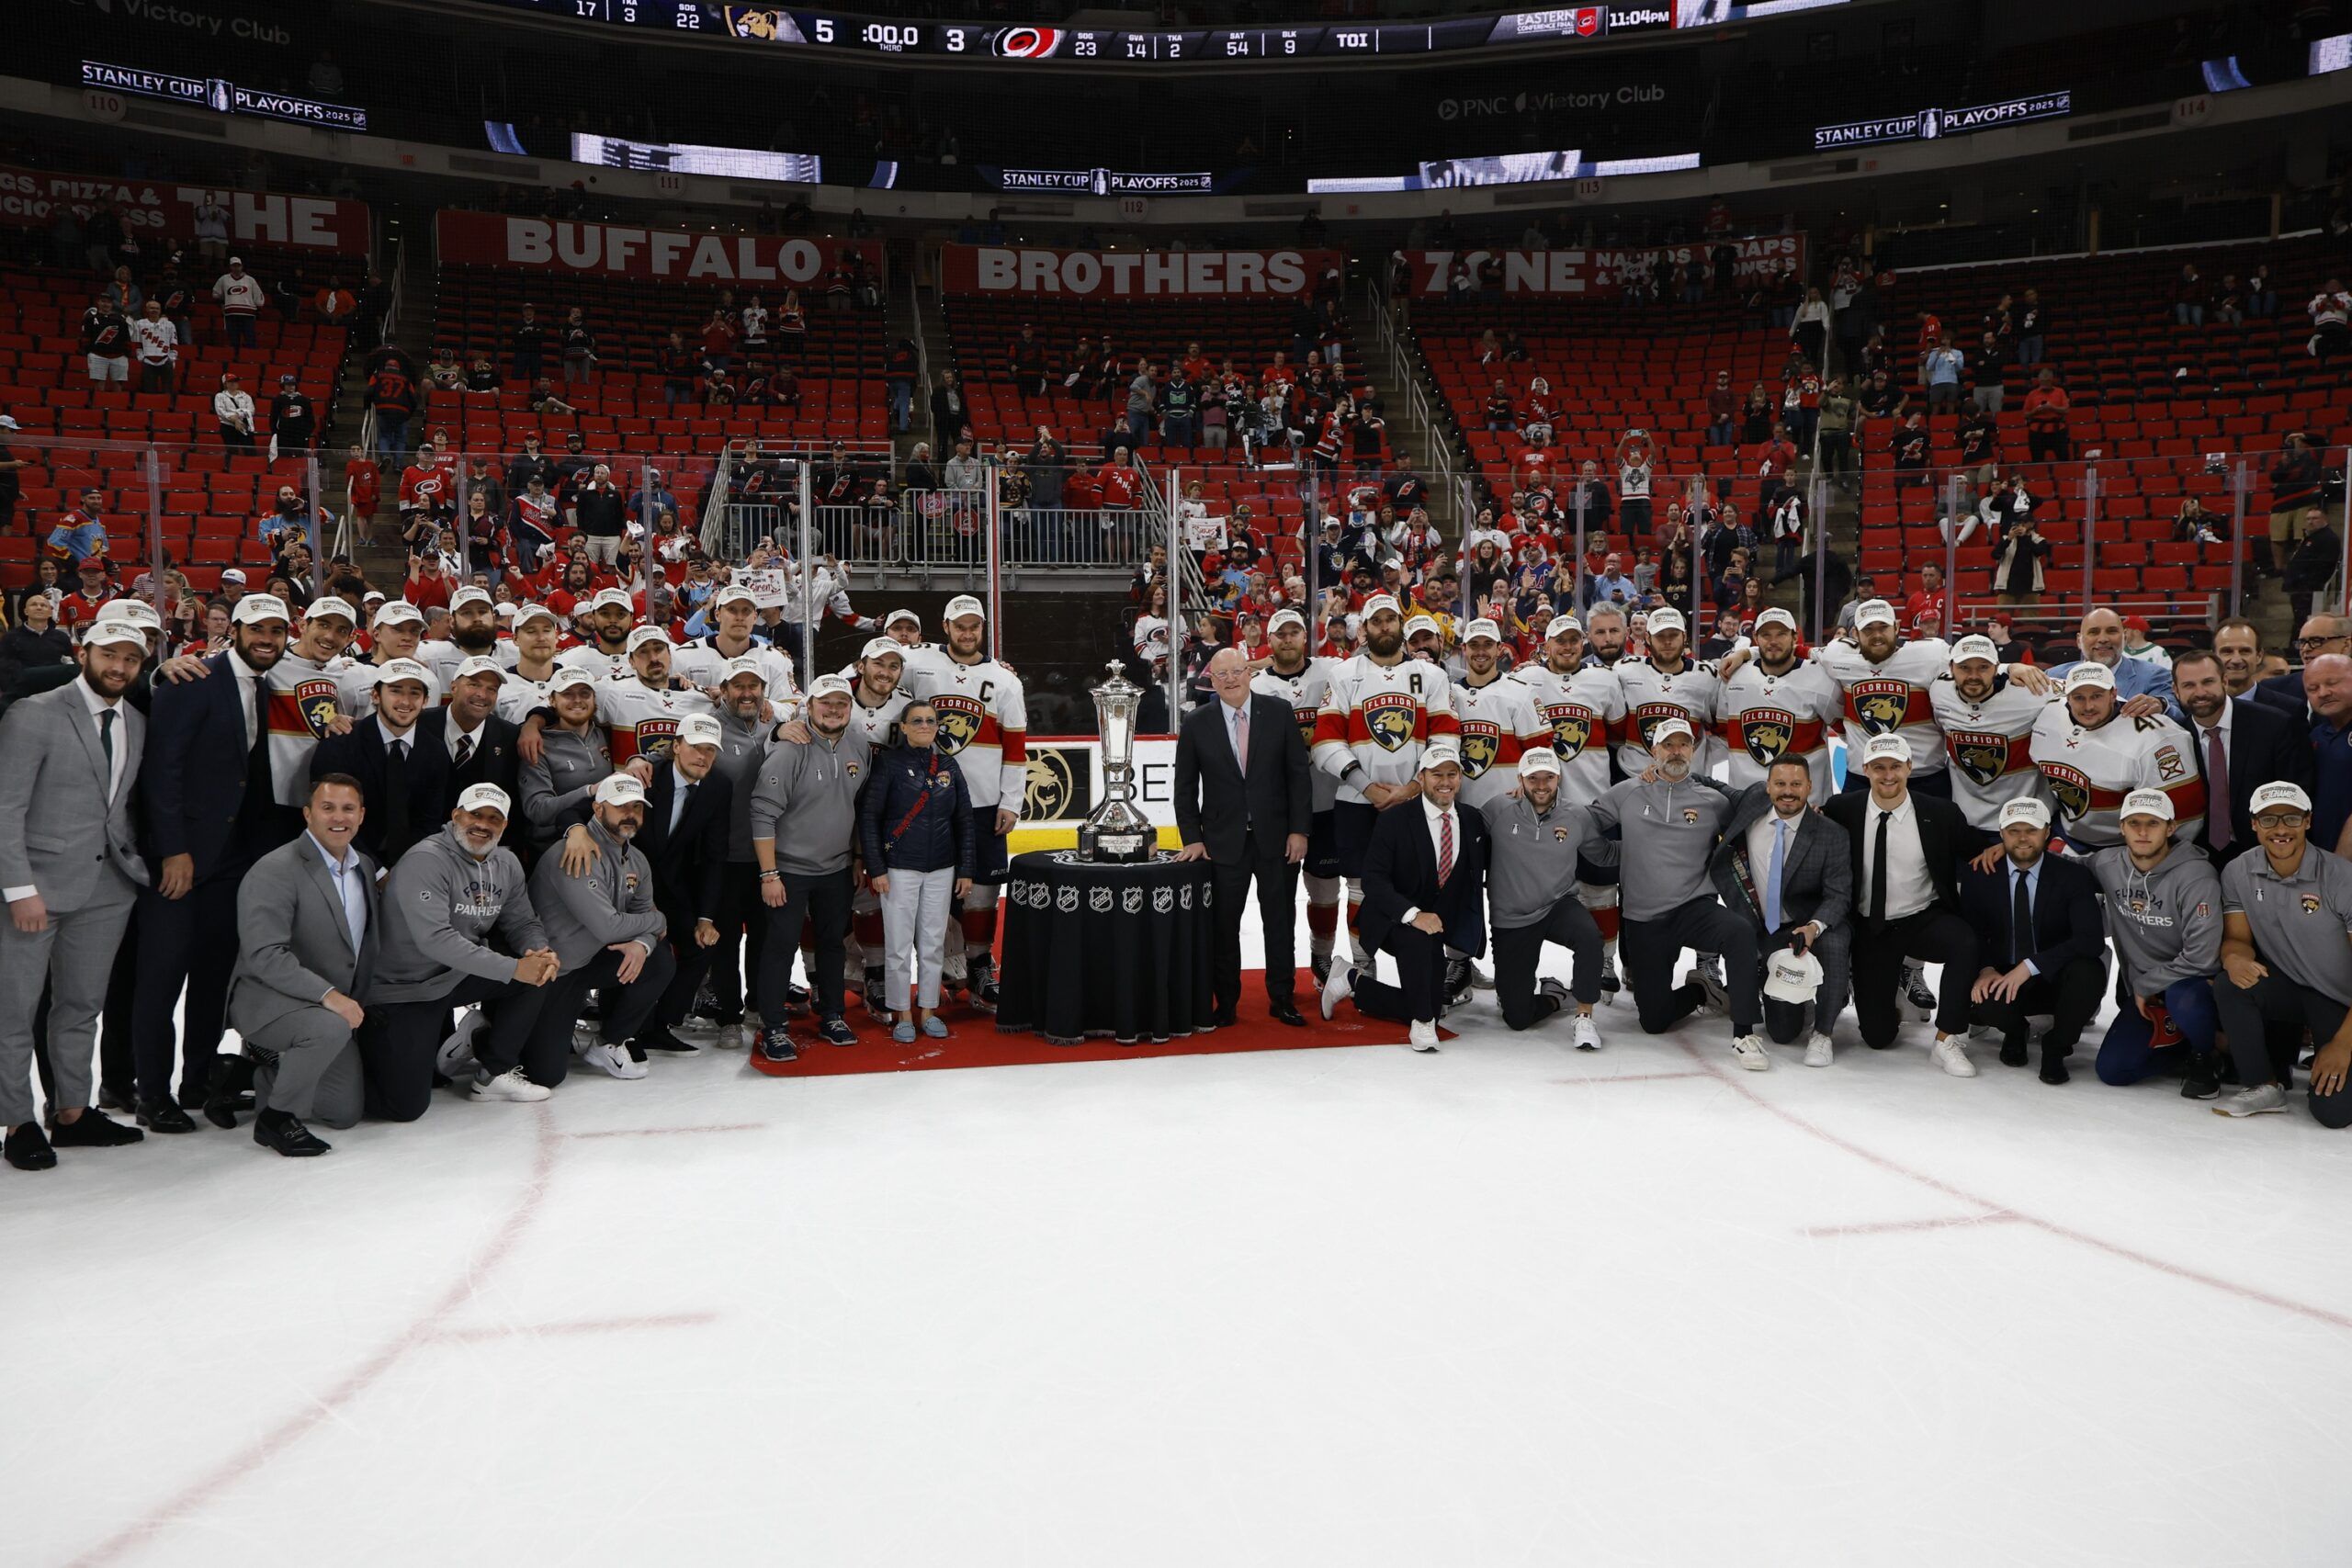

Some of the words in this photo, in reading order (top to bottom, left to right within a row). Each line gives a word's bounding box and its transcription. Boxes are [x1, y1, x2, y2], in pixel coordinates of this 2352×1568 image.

[576, 0, 596, 17] 17
[625, 7, 635, 23] 3
[678, 4, 696, 12] SOG
[676, 13, 699, 29] 22
[1517, 9, 1575, 27] EASTERN
[1609, 10, 1670, 28] 11:04PM
[231, 17, 291, 45] Club
[816, 18, 834, 43] 5
[862, 24, 919, 45] :00.0
[878, 43, 902, 52] THIRD
[946, 28, 965, 51] 3
[1284, 39, 1295, 54] 9
[1336, 33, 1368, 48] TOI
[1075, 41, 1096, 56] 23
[1126, 43, 1146, 58] 14
[1170, 43, 1180, 58] 2
[1227, 41, 1249, 56] 54
[82, 63, 164, 92] STANLEY
[169, 79, 203, 98] CUP
[91, 96, 119, 112] 110
[234, 90, 323, 120] PLAYOFFS
[325, 110, 350, 121] 2025
[1463, 96, 1508, 117] PNC
[1616, 84, 1665, 105] Club
[2180, 99, 2205, 117] 114
[1944, 101, 2028, 129] PLAYOFFS
[2030, 99, 2053, 111] 2025
[1815, 124, 1883, 144] STANLEY
[1886, 118, 1917, 136] CUP
[661, 175, 680, 190] 111
[1003, 173, 1060, 186] STANLEY
[1064, 175, 1089, 187] CUP
[1112, 176, 1178, 189] PLAYOFFS
[1580, 180, 1600, 194] 113
[140, 186, 161, 206] &
[1124, 200, 1143, 213] 112
[177, 186, 338, 247] THE
[507, 217, 822, 283] BUFFALO
[978, 247, 1306, 295] BROTHERS
[141, 328, 169, 354] CANES
[380, 378, 405, 399] 37
[979, 681, 994, 701] C
[1408, 673, 1423, 694] A
[1857, 682, 1903, 695] FLORIDA
[934, 698, 980, 714] FLORIDA
[1368, 695, 1412, 709] FLORIDA
[1545, 706, 1588, 719] FLORIDA
[1642, 705, 1685, 720] FLORIDA
[1746, 709, 1790, 724] FLORIDA
[1954, 734, 2002, 745] FLORIDA
[2042, 764, 2086, 787] FLORIDA
